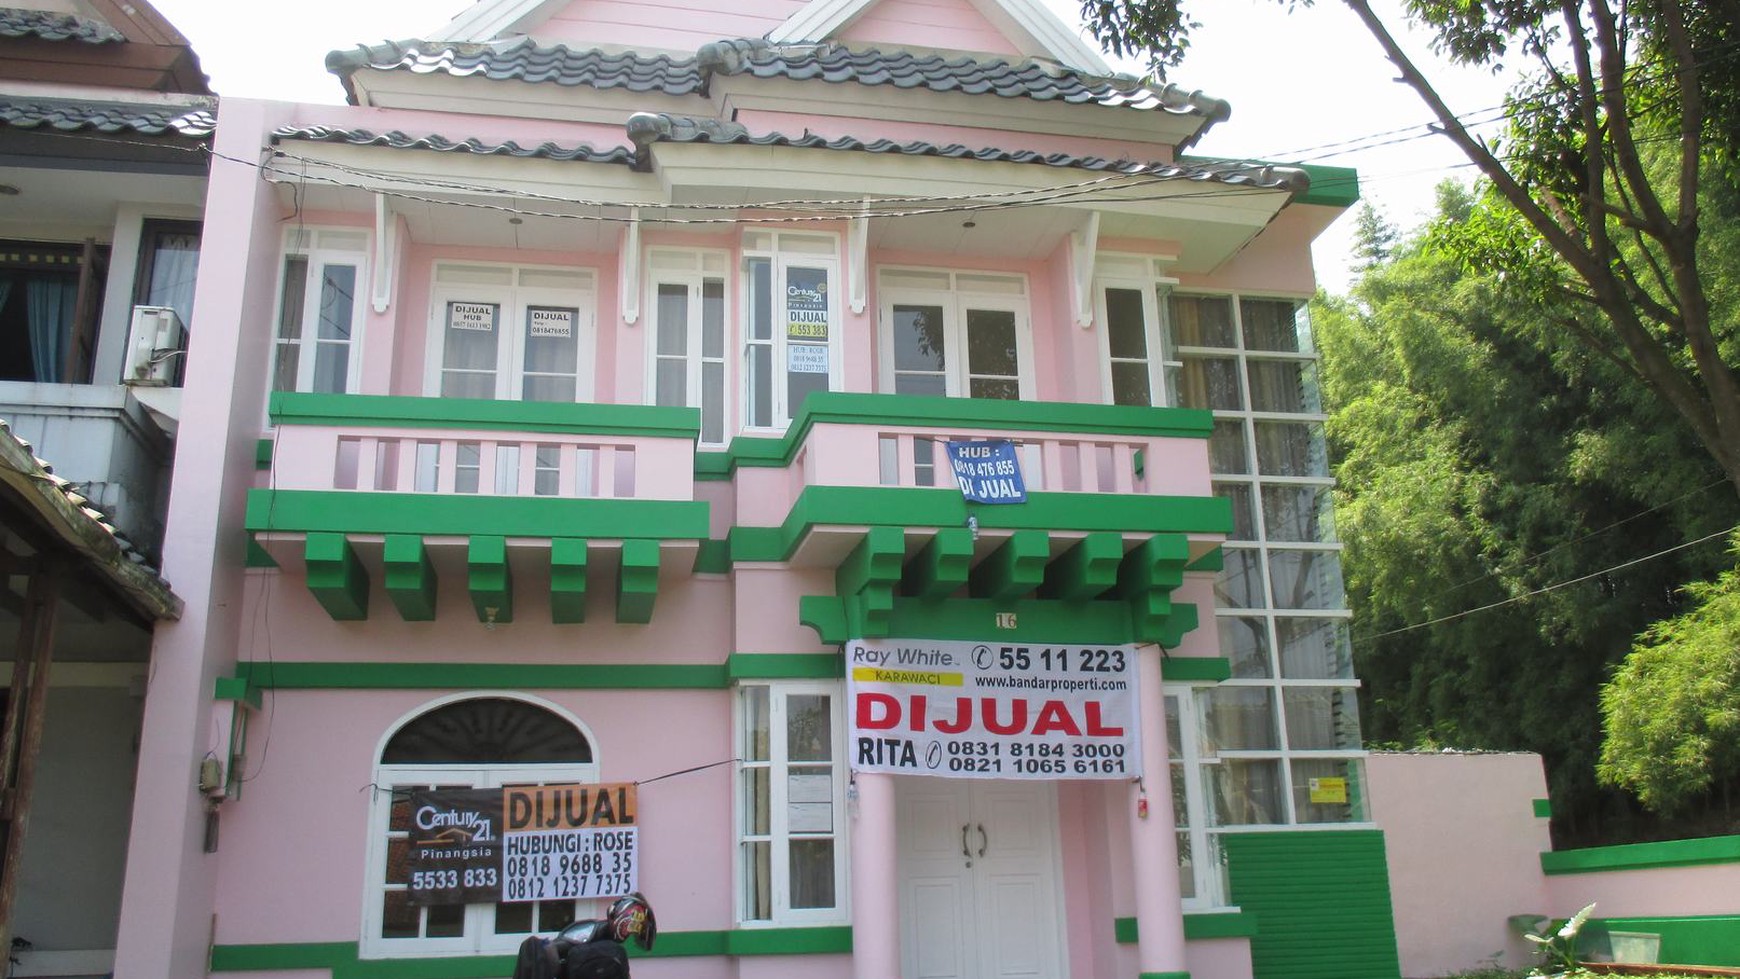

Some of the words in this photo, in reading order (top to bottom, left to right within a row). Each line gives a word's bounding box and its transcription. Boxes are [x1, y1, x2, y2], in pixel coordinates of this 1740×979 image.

[812, 293, 822, 302] 21
[456, 305, 491, 314] DIJUAL
[534, 312, 569, 320] DIJUAL
[790, 312, 827, 322] DIJUAL
[797, 325, 811, 335] 553
[959, 447, 990, 458] HUB
[954, 458, 976, 476] 0818
[977, 462, 995, 476] 476
[996, 460, 1014, 476] 855
[958, 476, 976, 496] DI
[978, 478, 1022, 498] JUAL
[996, 614, 1016, 628] 16
[853, 646, 891, 667] Ray
[897, 648, 953, 666] White
[1000, 648, 1030, 668] 55
[1040, 649, 1068, 671] 11
[1080, 650, 1126, 672] 223
[875, 671, 940, 684] KARAWACI
[975, 676, 1127, 693] www.bandarproperti.com
[856, 692, 1124, 737] DIJUAL
[858, 737, 918, 768] RITA
[947, 741, 1000, 756] 0831
[1010, 742, 1064, 757] 8184
[1072, 743, 1125, 758] 3000
[949, 758, 1001, 773] 0821
[1012, 758, 1066, 773] 1065
[1074, 758, 1125, 773] 6161
[509, 788, 634, 829] DIJUAL
[416, 806, 480, 830] Century
[472, 820, 491, 842] 21
[507, 834, 581, 856] HUBUNGI
[593, 831, 633, 852] ROSE
[421, 848, 492, 860] Pinangsia
[507, 855, 550, 877] 0818
[560, 853, 602, 875] 9688
[612, 852, 632, 873] 35
[413, 870, 458, 890] 5533
[464, 868, 497, 888] 833
[508, 877, 545, 900] 0812
[553, 876, 588, 897] 1237
[596, 873, 632, 895] 7375
